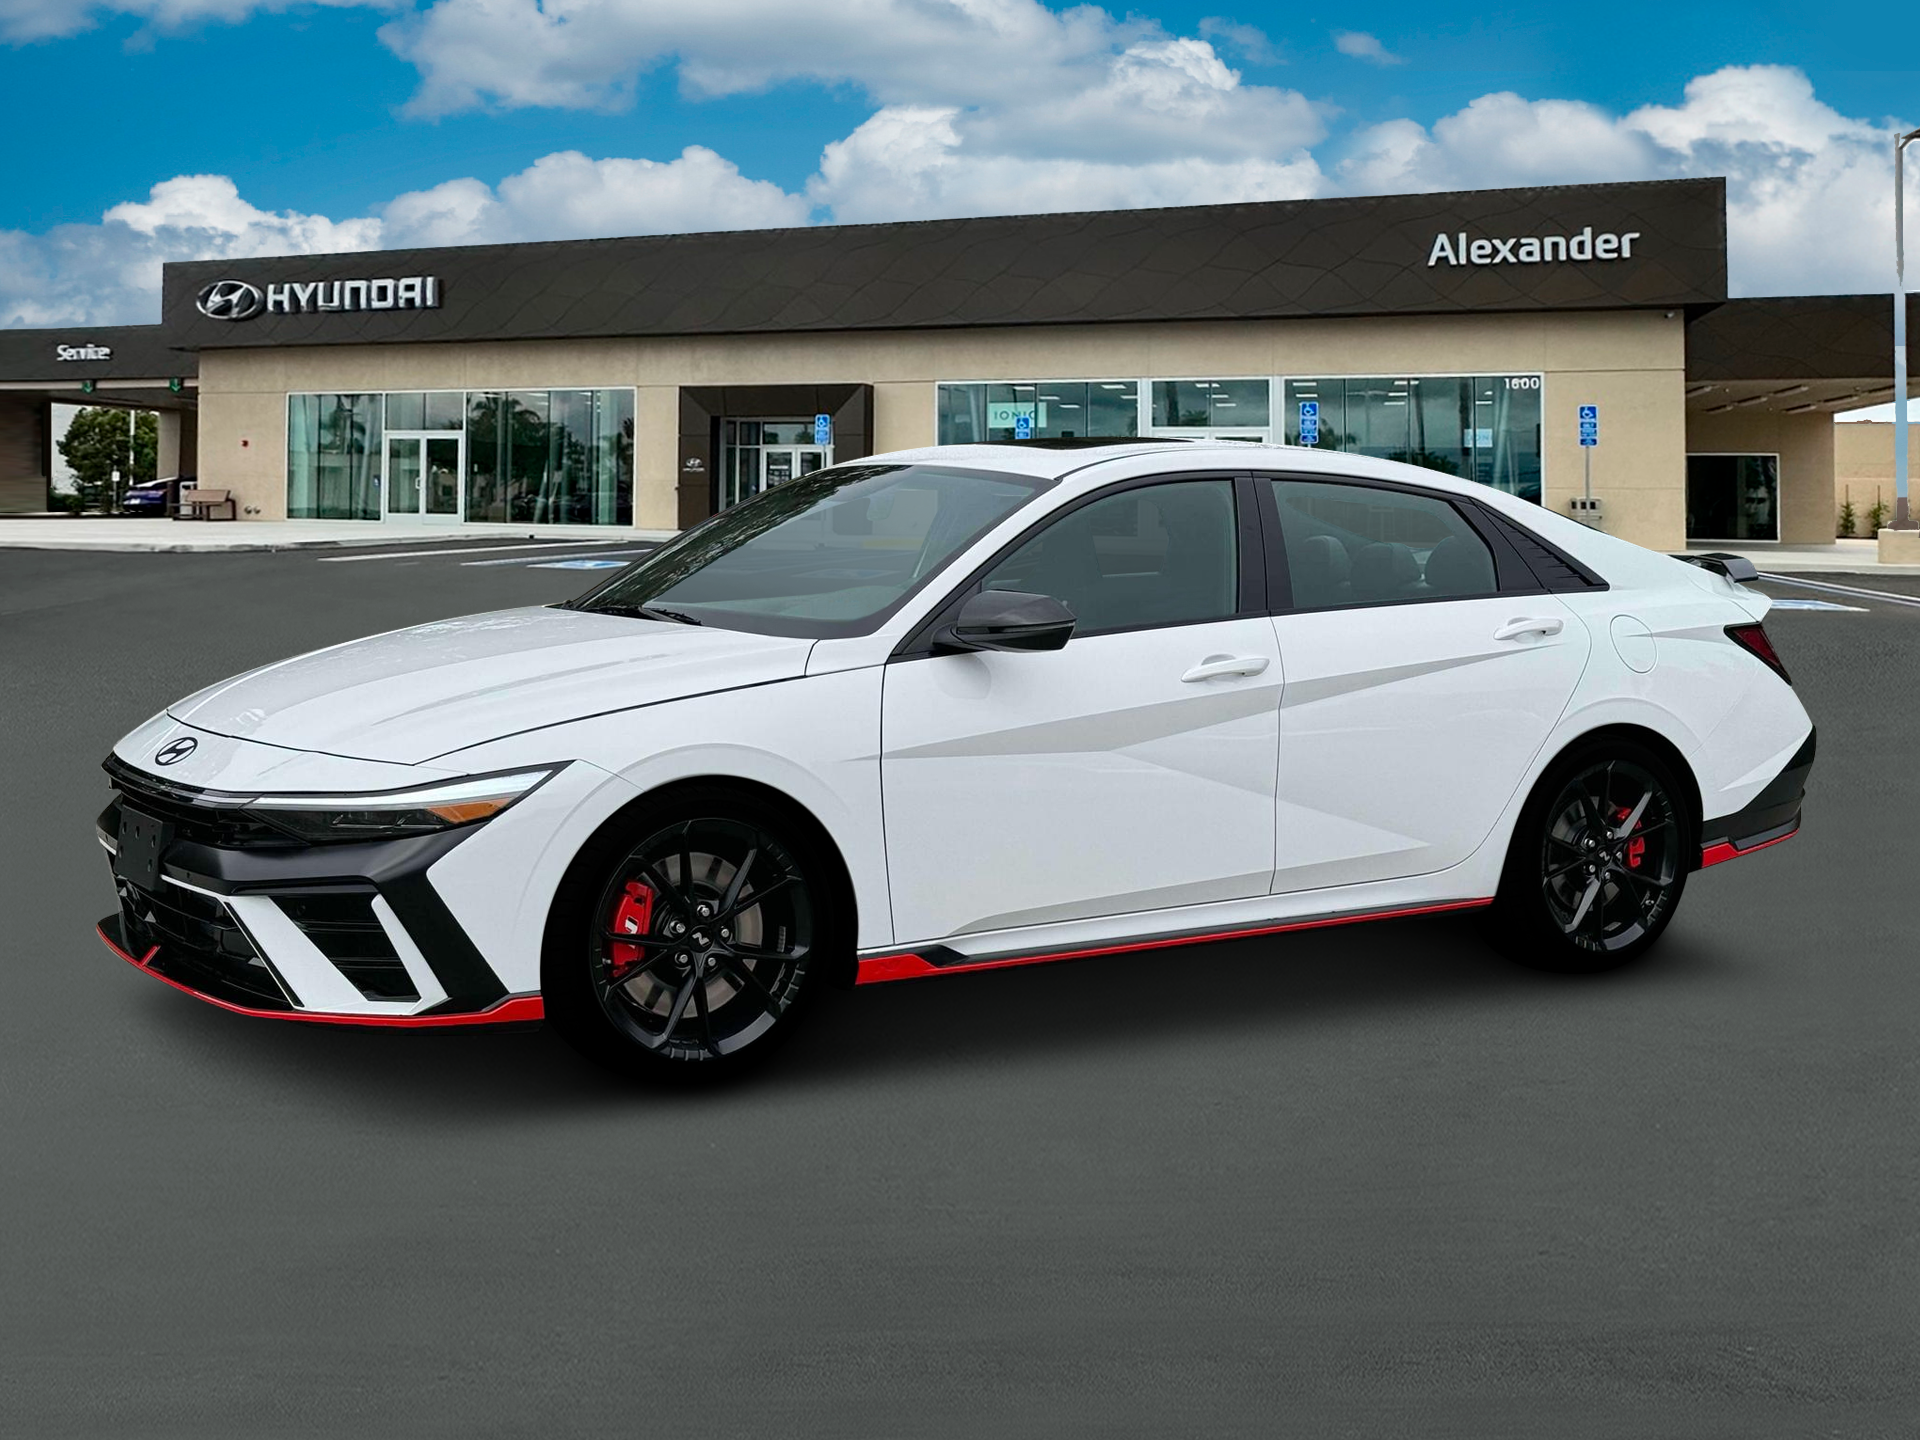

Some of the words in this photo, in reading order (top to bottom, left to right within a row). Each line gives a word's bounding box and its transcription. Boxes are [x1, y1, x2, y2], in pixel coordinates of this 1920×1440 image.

[1428, 227, 1640, 267] Alexander
[267, 277, 437, 312] HYUNDAI
[56, 345, 111, 361] Service
[1504, 377, 1540, 389] 1600
